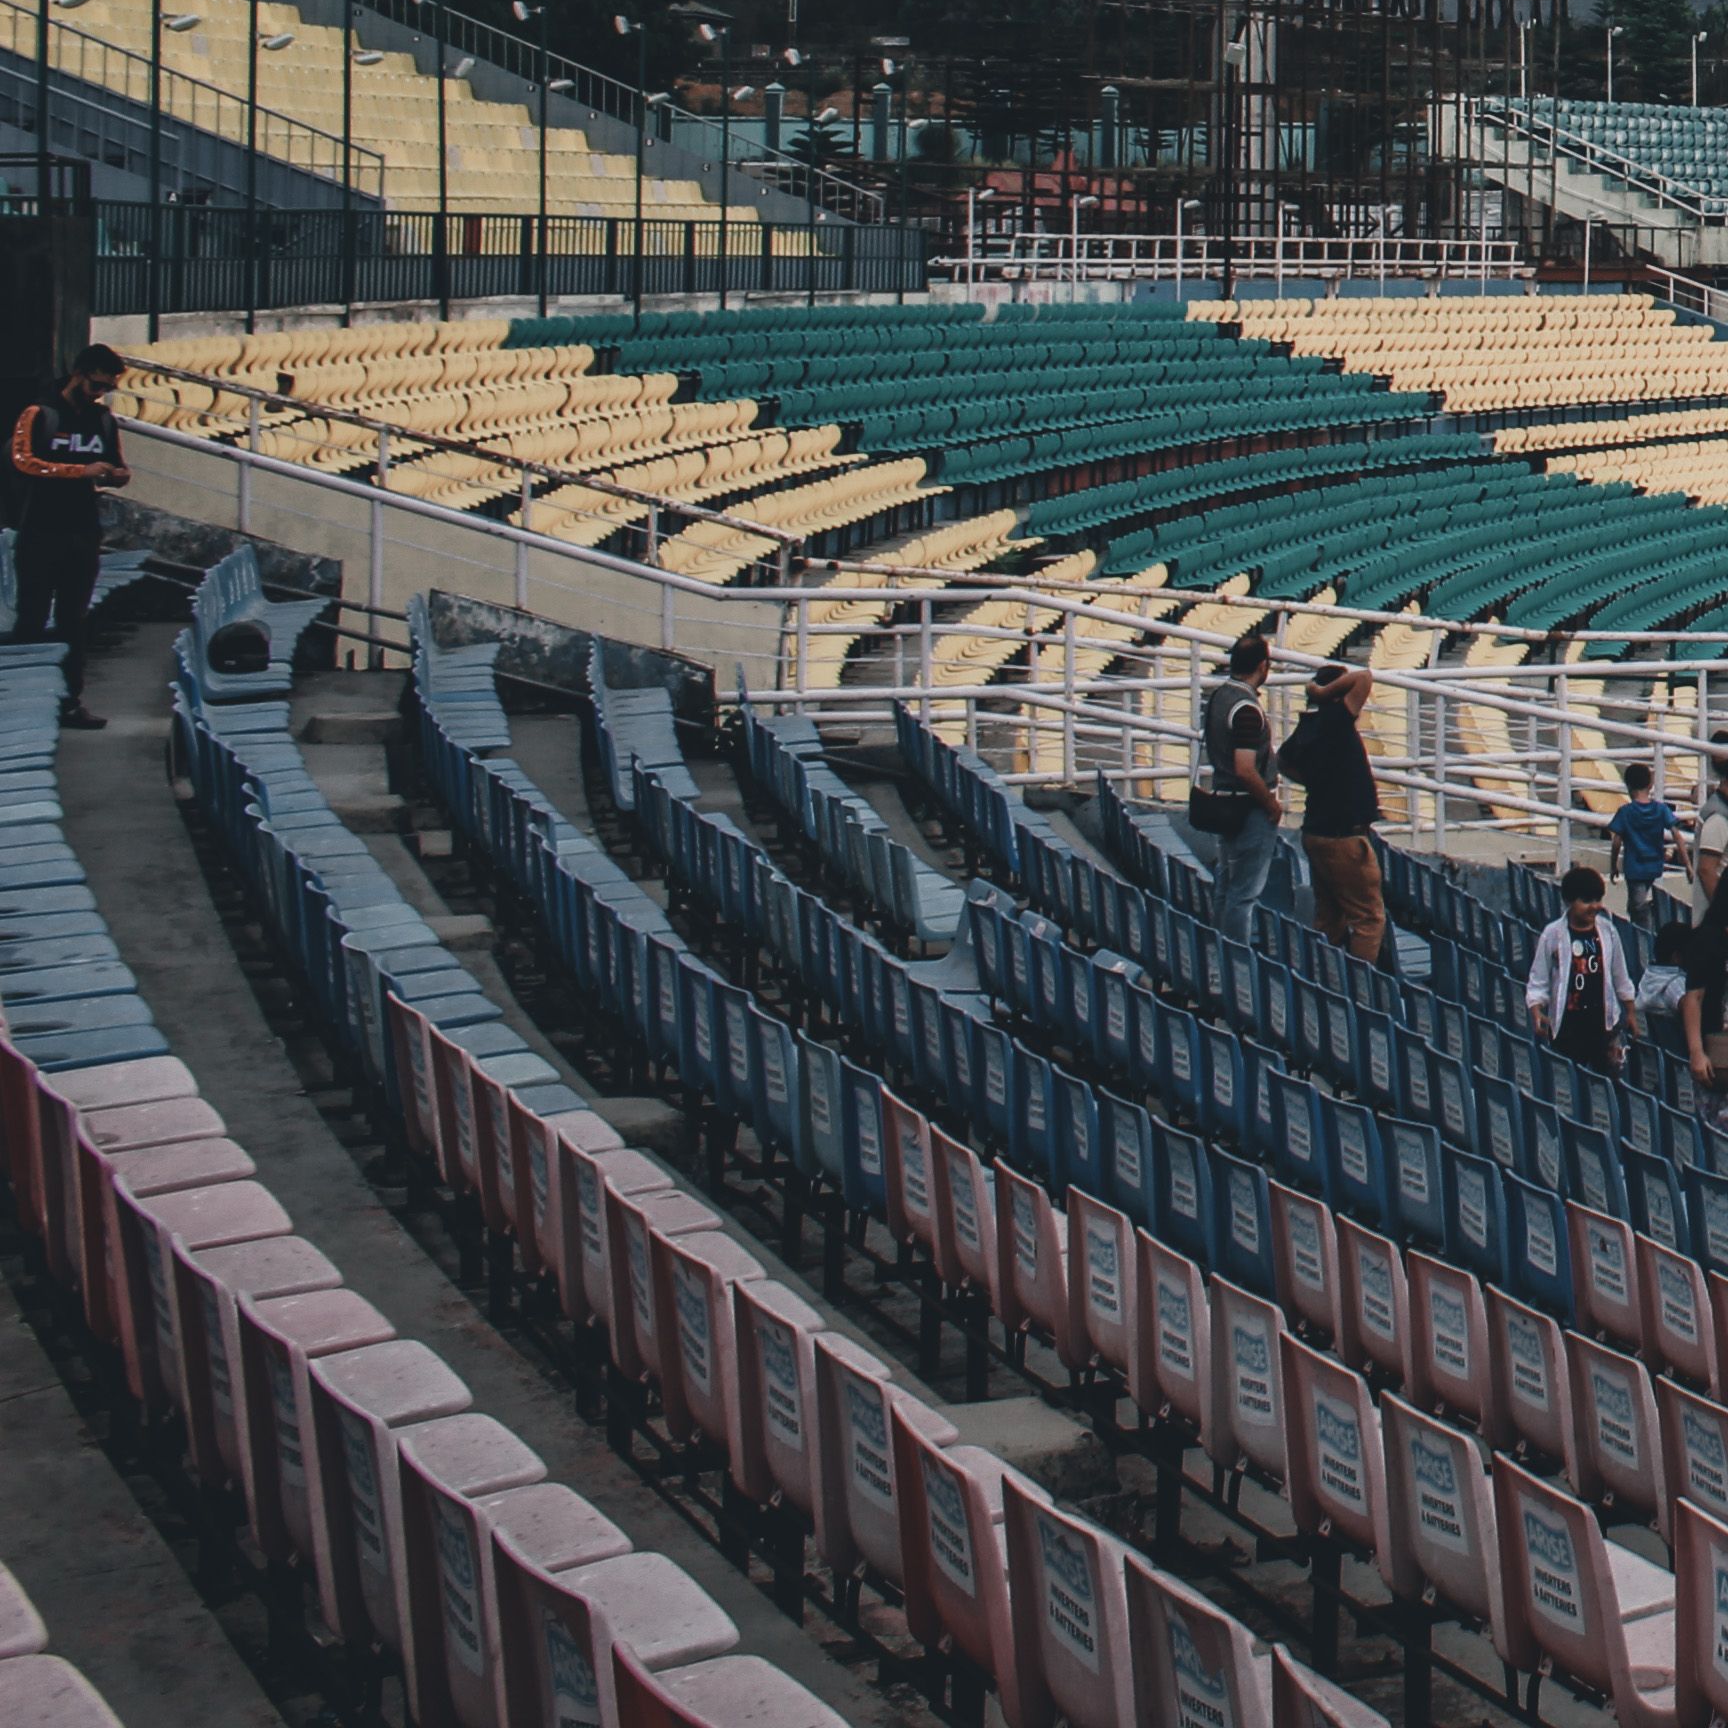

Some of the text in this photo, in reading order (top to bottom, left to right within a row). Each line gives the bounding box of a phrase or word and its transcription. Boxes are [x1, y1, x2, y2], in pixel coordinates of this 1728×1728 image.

[51, 432, 104, 454] FILA
[1527, 1518, 1573, 1565] ARISE
[1535, 1567, 1571, 1595] INVERTERS
[1540, 1588, 1577, 1616] BATTERIES
